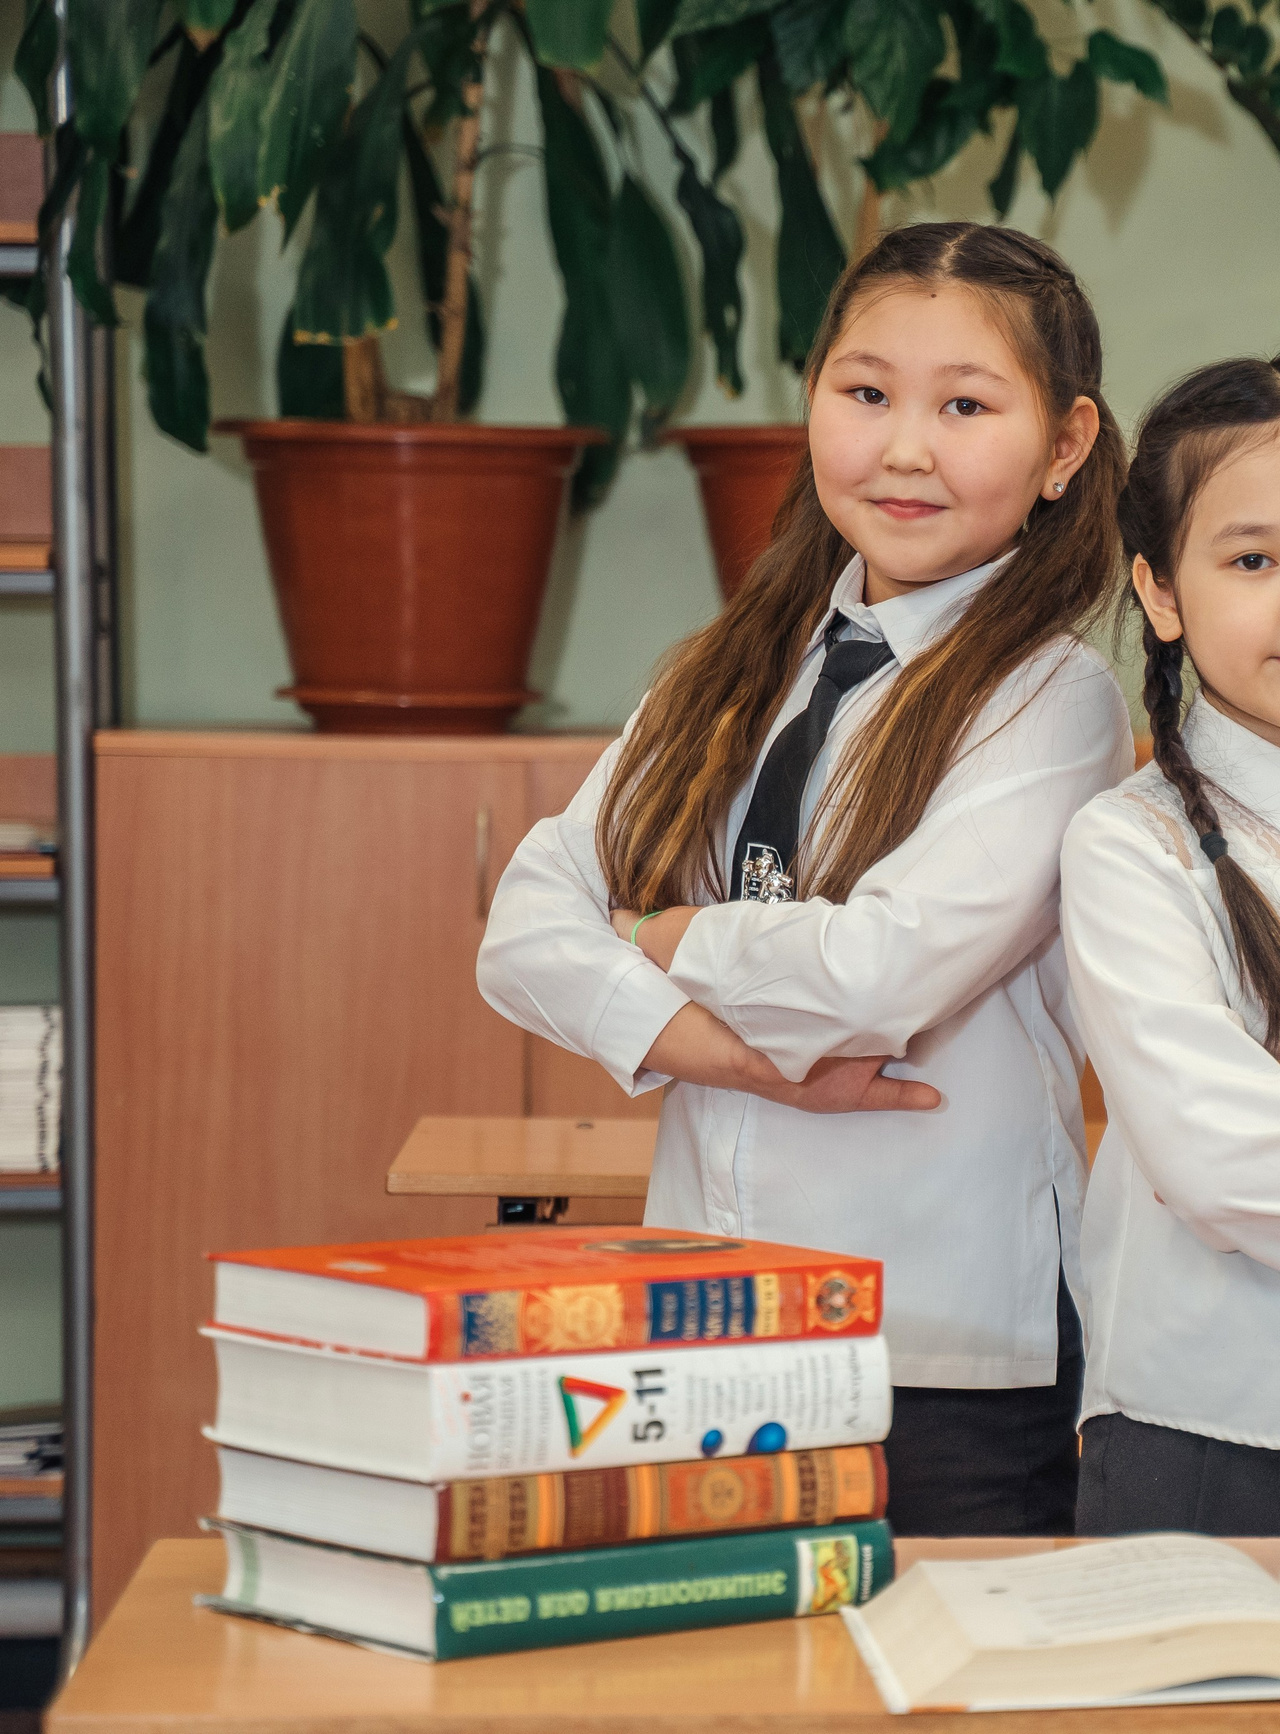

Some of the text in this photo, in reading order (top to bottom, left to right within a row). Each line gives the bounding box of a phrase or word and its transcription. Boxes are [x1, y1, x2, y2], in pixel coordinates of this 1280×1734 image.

[466, 1375, 493, 1471] НОВАЯ
[632, 1368, 666, 1443] 5-11
[450, 1570, 788, 1634] ЭНЦИКЛОПЕДИЯ ДЛЯ ДЕТЕЙ
